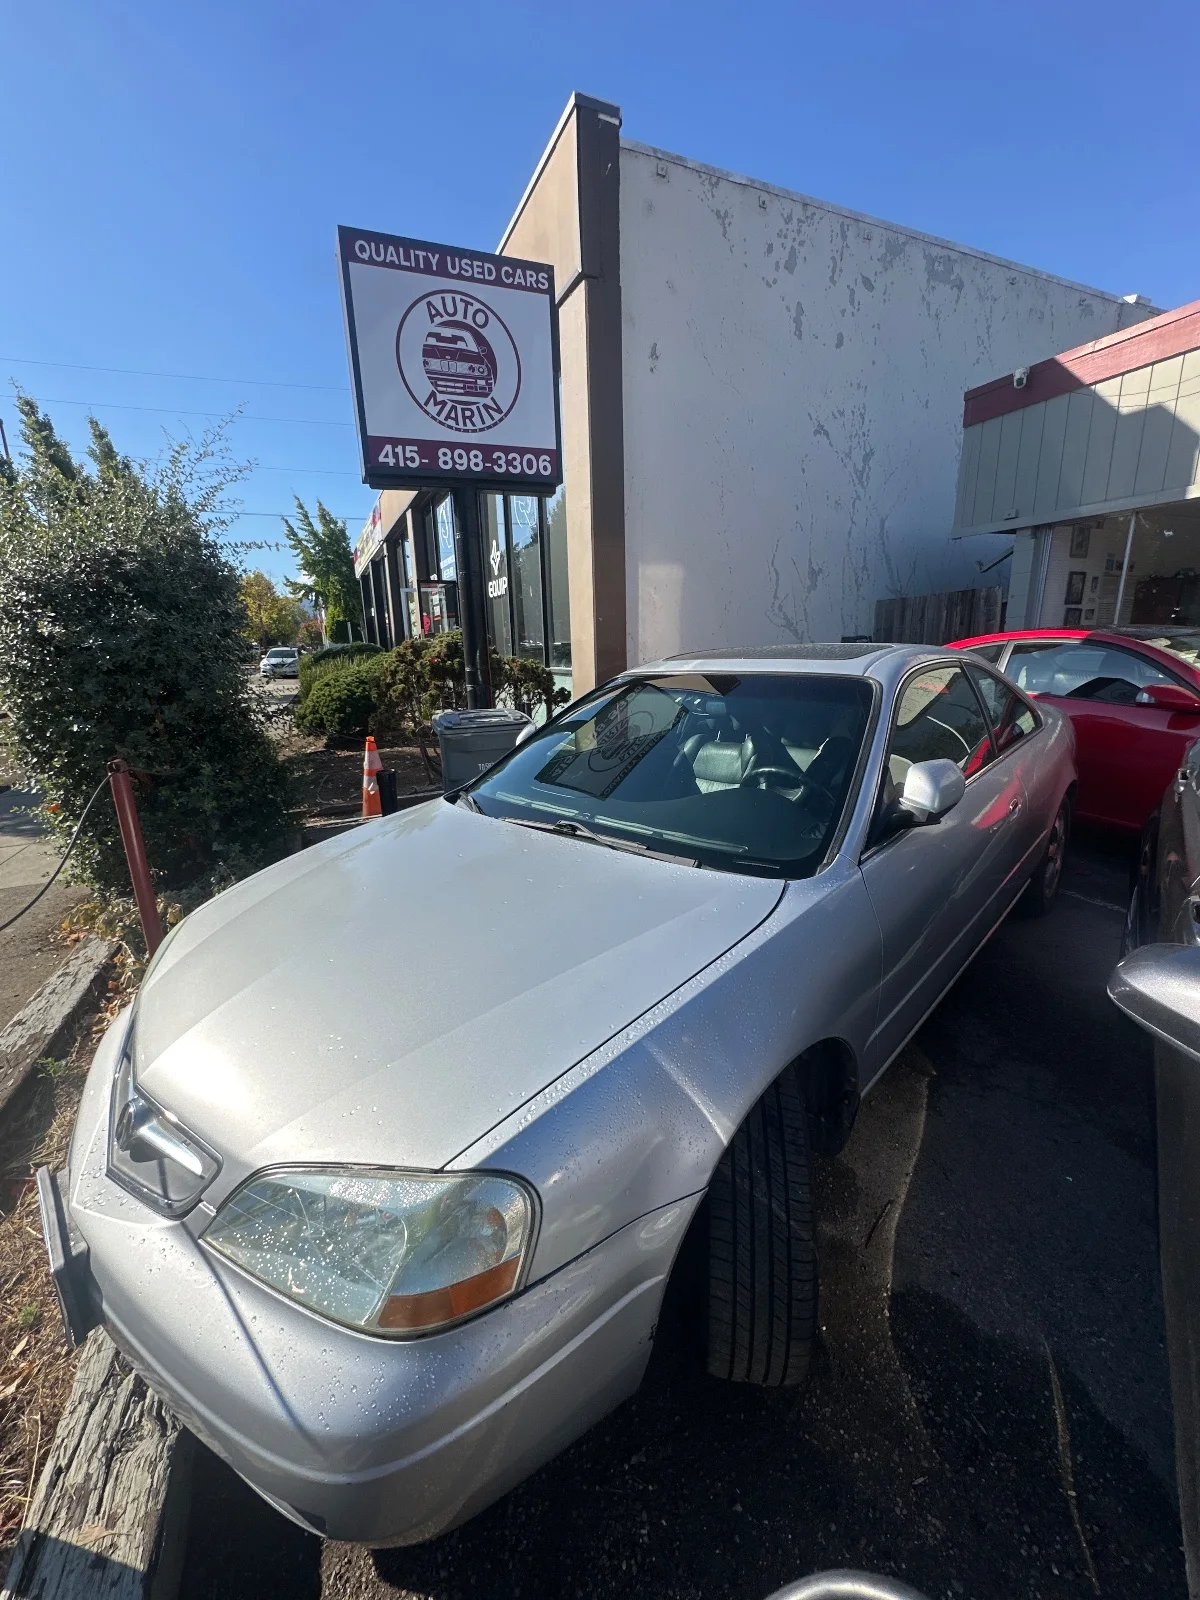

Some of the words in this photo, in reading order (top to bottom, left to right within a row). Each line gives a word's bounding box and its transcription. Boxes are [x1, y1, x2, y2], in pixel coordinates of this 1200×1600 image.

[354, 239, 440, 271] QUALITY
[447, 257, 497, 281] USED
[501, 266, 549, 290] CARS
[426, 296, 489, 329] AUTO
[423, 390, 504, 427] MARIN
[378, 444, 429, 468] 415-
[438, 447, 552, 476] 898-3306
[488, 577, 508, 598] EQUIP
